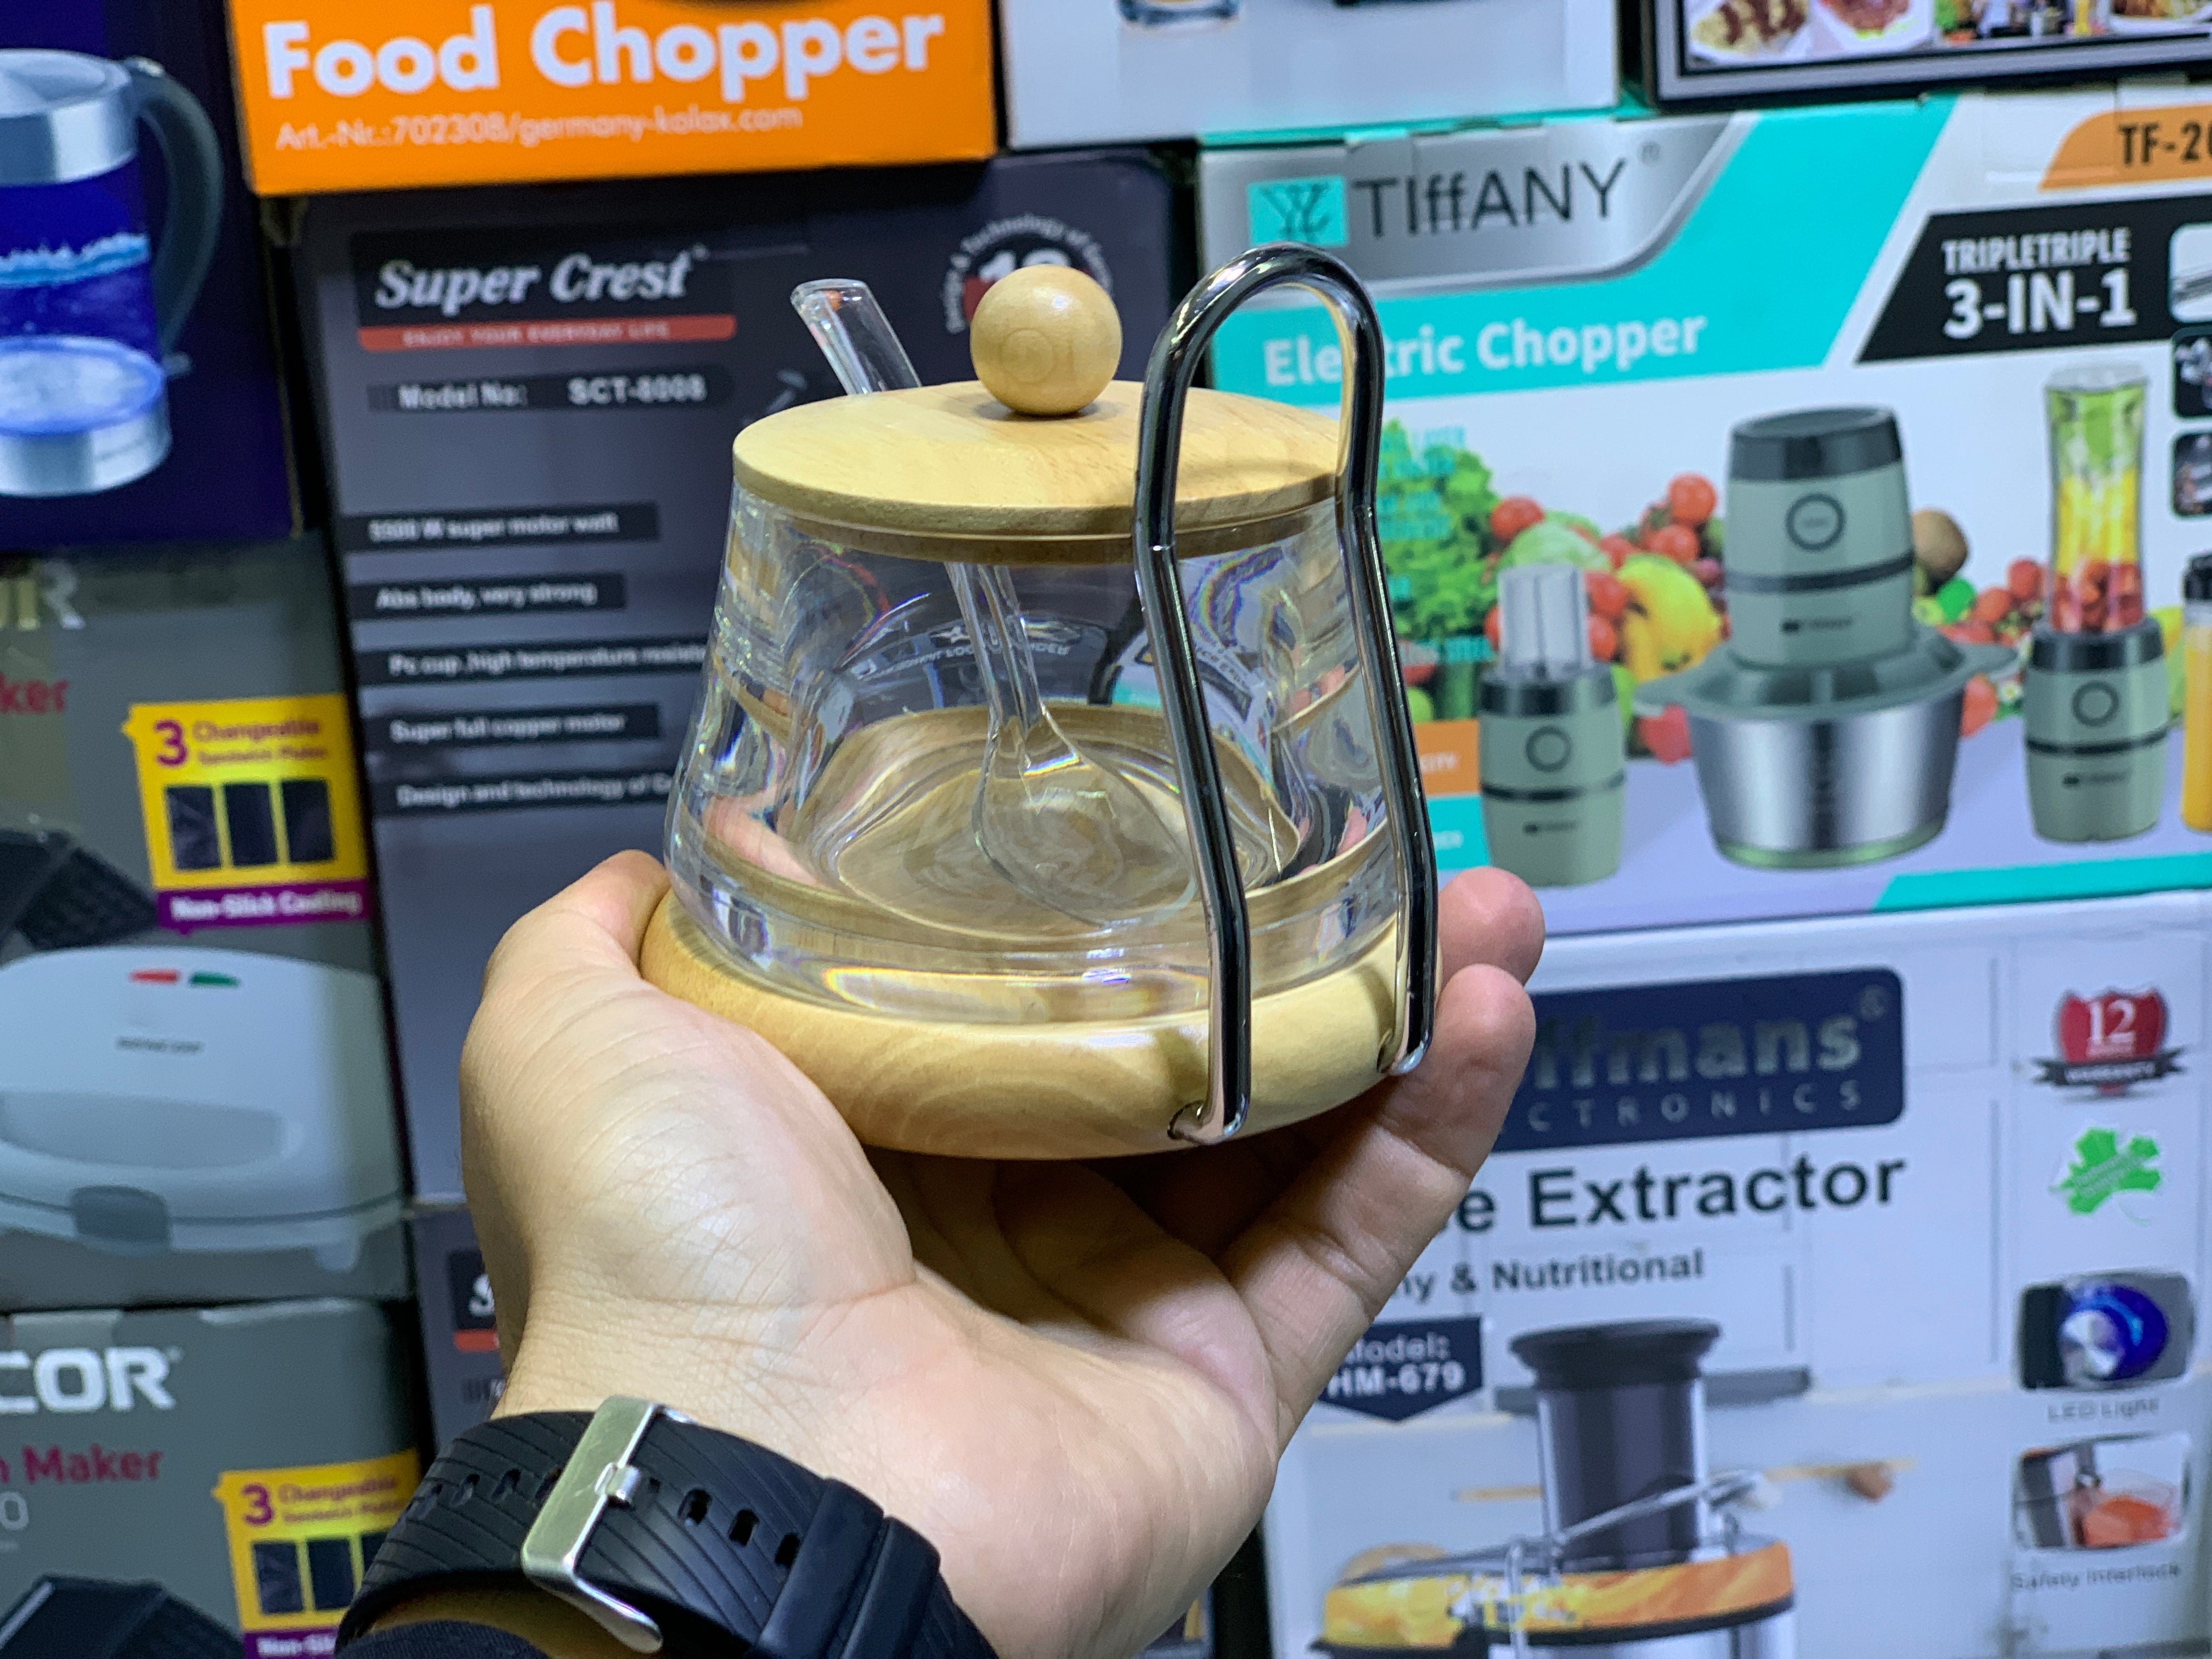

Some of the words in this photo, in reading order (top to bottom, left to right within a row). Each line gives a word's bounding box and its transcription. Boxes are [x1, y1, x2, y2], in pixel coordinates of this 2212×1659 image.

[262, 3, 500, 99] Food
[530, 0, 945, 103] Chopper
[1941, 226, 2132, 275] TRIPLETRIPLE
[375, 258, 541, 318] Super
[550, 249, 694, 303] Crest
[1942, 268, 2137, 341] 3-IN-1
[1264, 324, 1464, 386] Eletric
[1476, 315, 1708, 374] Chopper
[398, 383, 478, 409] Model
[154, 719, 188, 766] 3
[390, 720, 452, 743] Super
[2086, 1000, 2137, 1044] 12
[1527, 1079, 1862, 1133] CTRONICS
[1529, 1152, 1907, 1229] Extractor
[1449, 1263, 1477, 1293] &
[1493, 1248, 1704, 1290] Nutritional
[22, 1443, 163, 1484] Maker
[241, 1483, 275, 1527] 3
